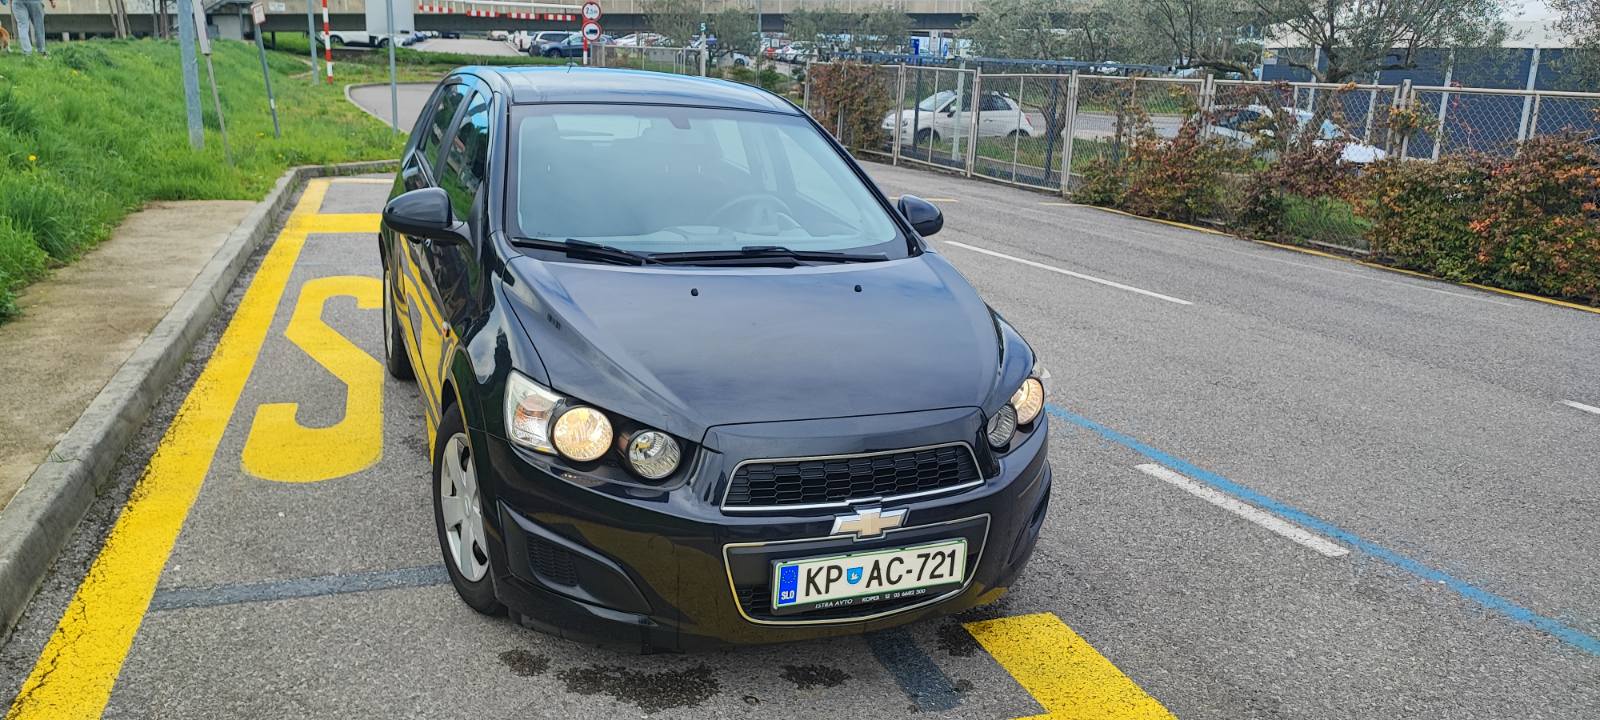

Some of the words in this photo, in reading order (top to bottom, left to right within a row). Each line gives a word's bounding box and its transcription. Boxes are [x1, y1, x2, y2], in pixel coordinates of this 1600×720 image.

[805, 564, 843, 597] KP
[865, 549, 957, 589] AC-721
[781, 590, 795, 600] SLO
[815, 601, 834, 609] ISTRA
[834, 598, 853, 607] AVTO
